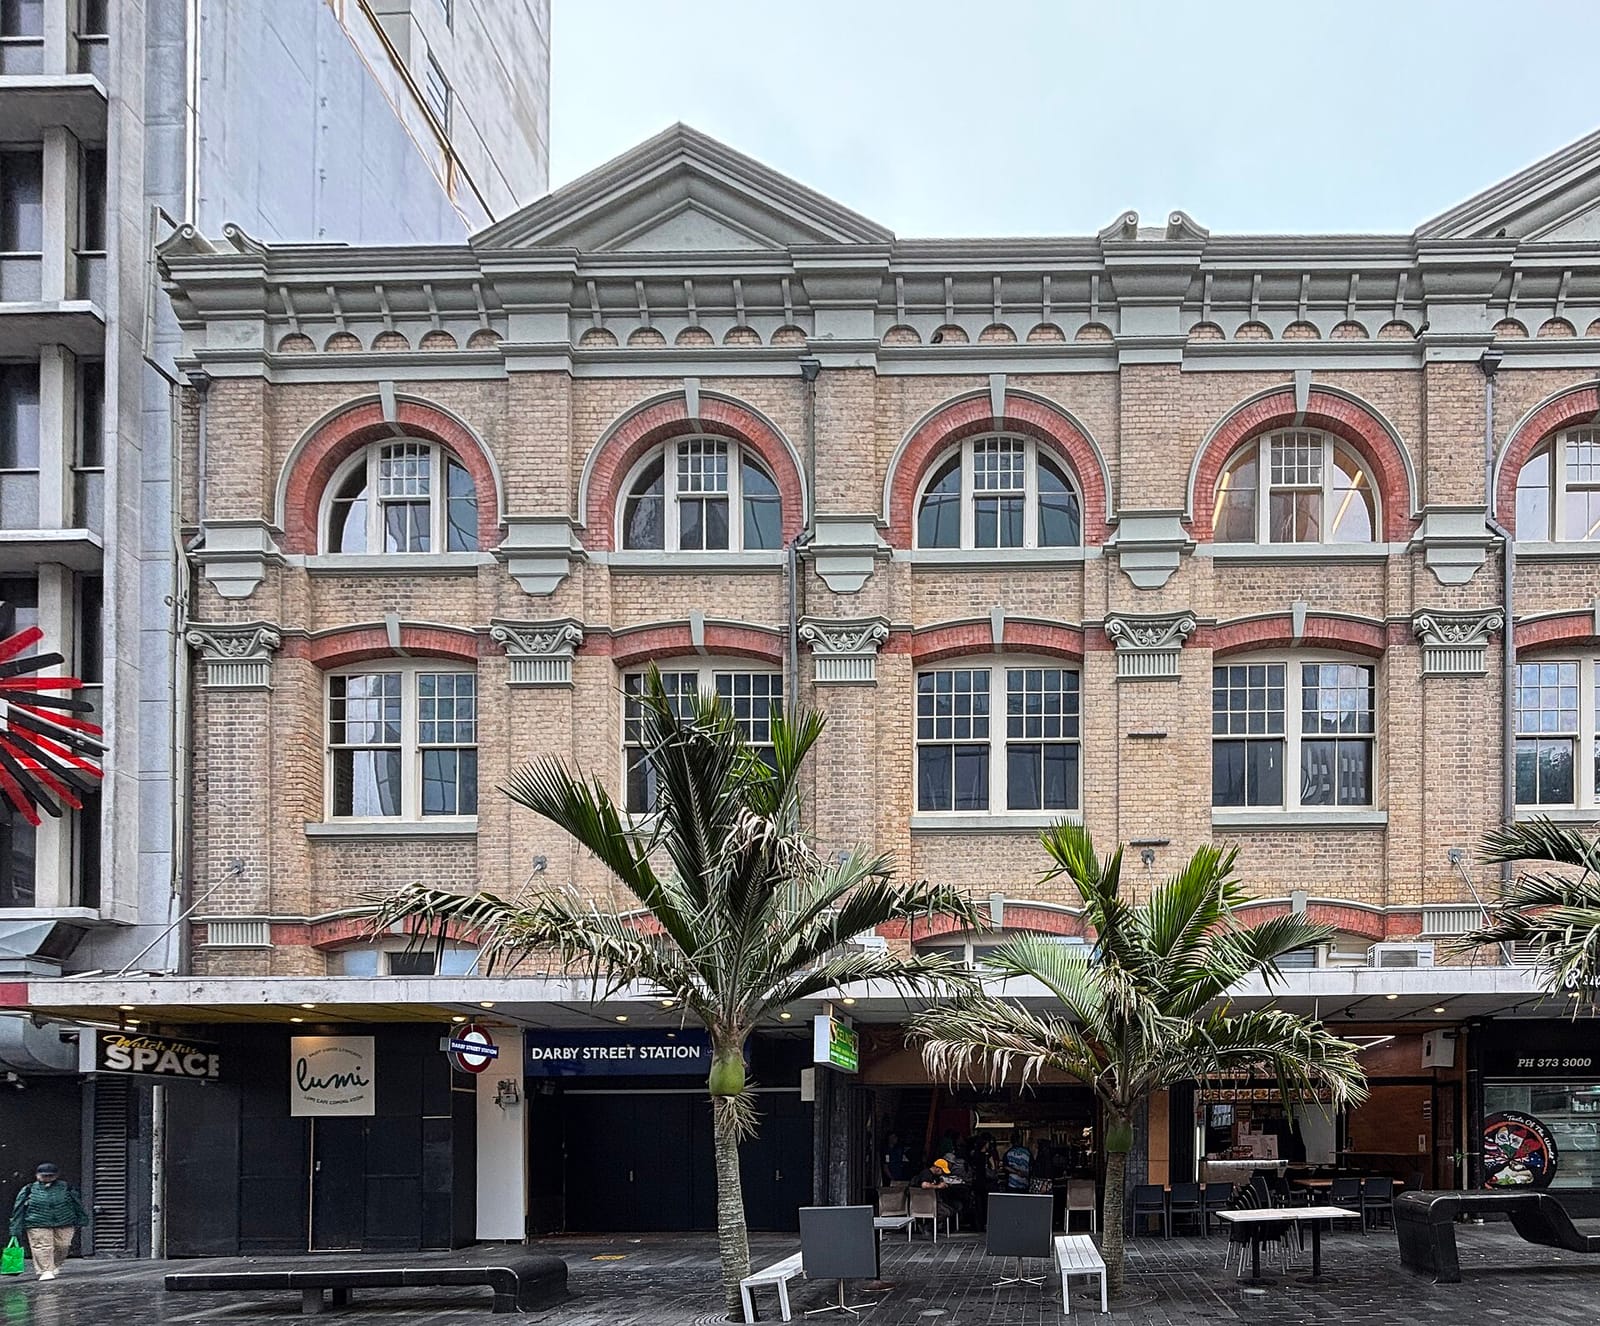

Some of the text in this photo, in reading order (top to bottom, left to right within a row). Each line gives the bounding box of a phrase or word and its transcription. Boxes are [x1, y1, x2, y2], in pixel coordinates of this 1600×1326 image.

[104, 1044, 220, 1077] SPACE
[531, 1047, 579, 1060] DARBY
[582, 1047, 635, 1060] STREET
[639, 1046, 700, 1059] STATION
[1517, 1058, 1592, 1067] PH 373 3000
[297, 1057, 369, 1091] lumi
[1525, 1119, 1535, 1129] Of
[1535, 1124, 1545, 1138] The
